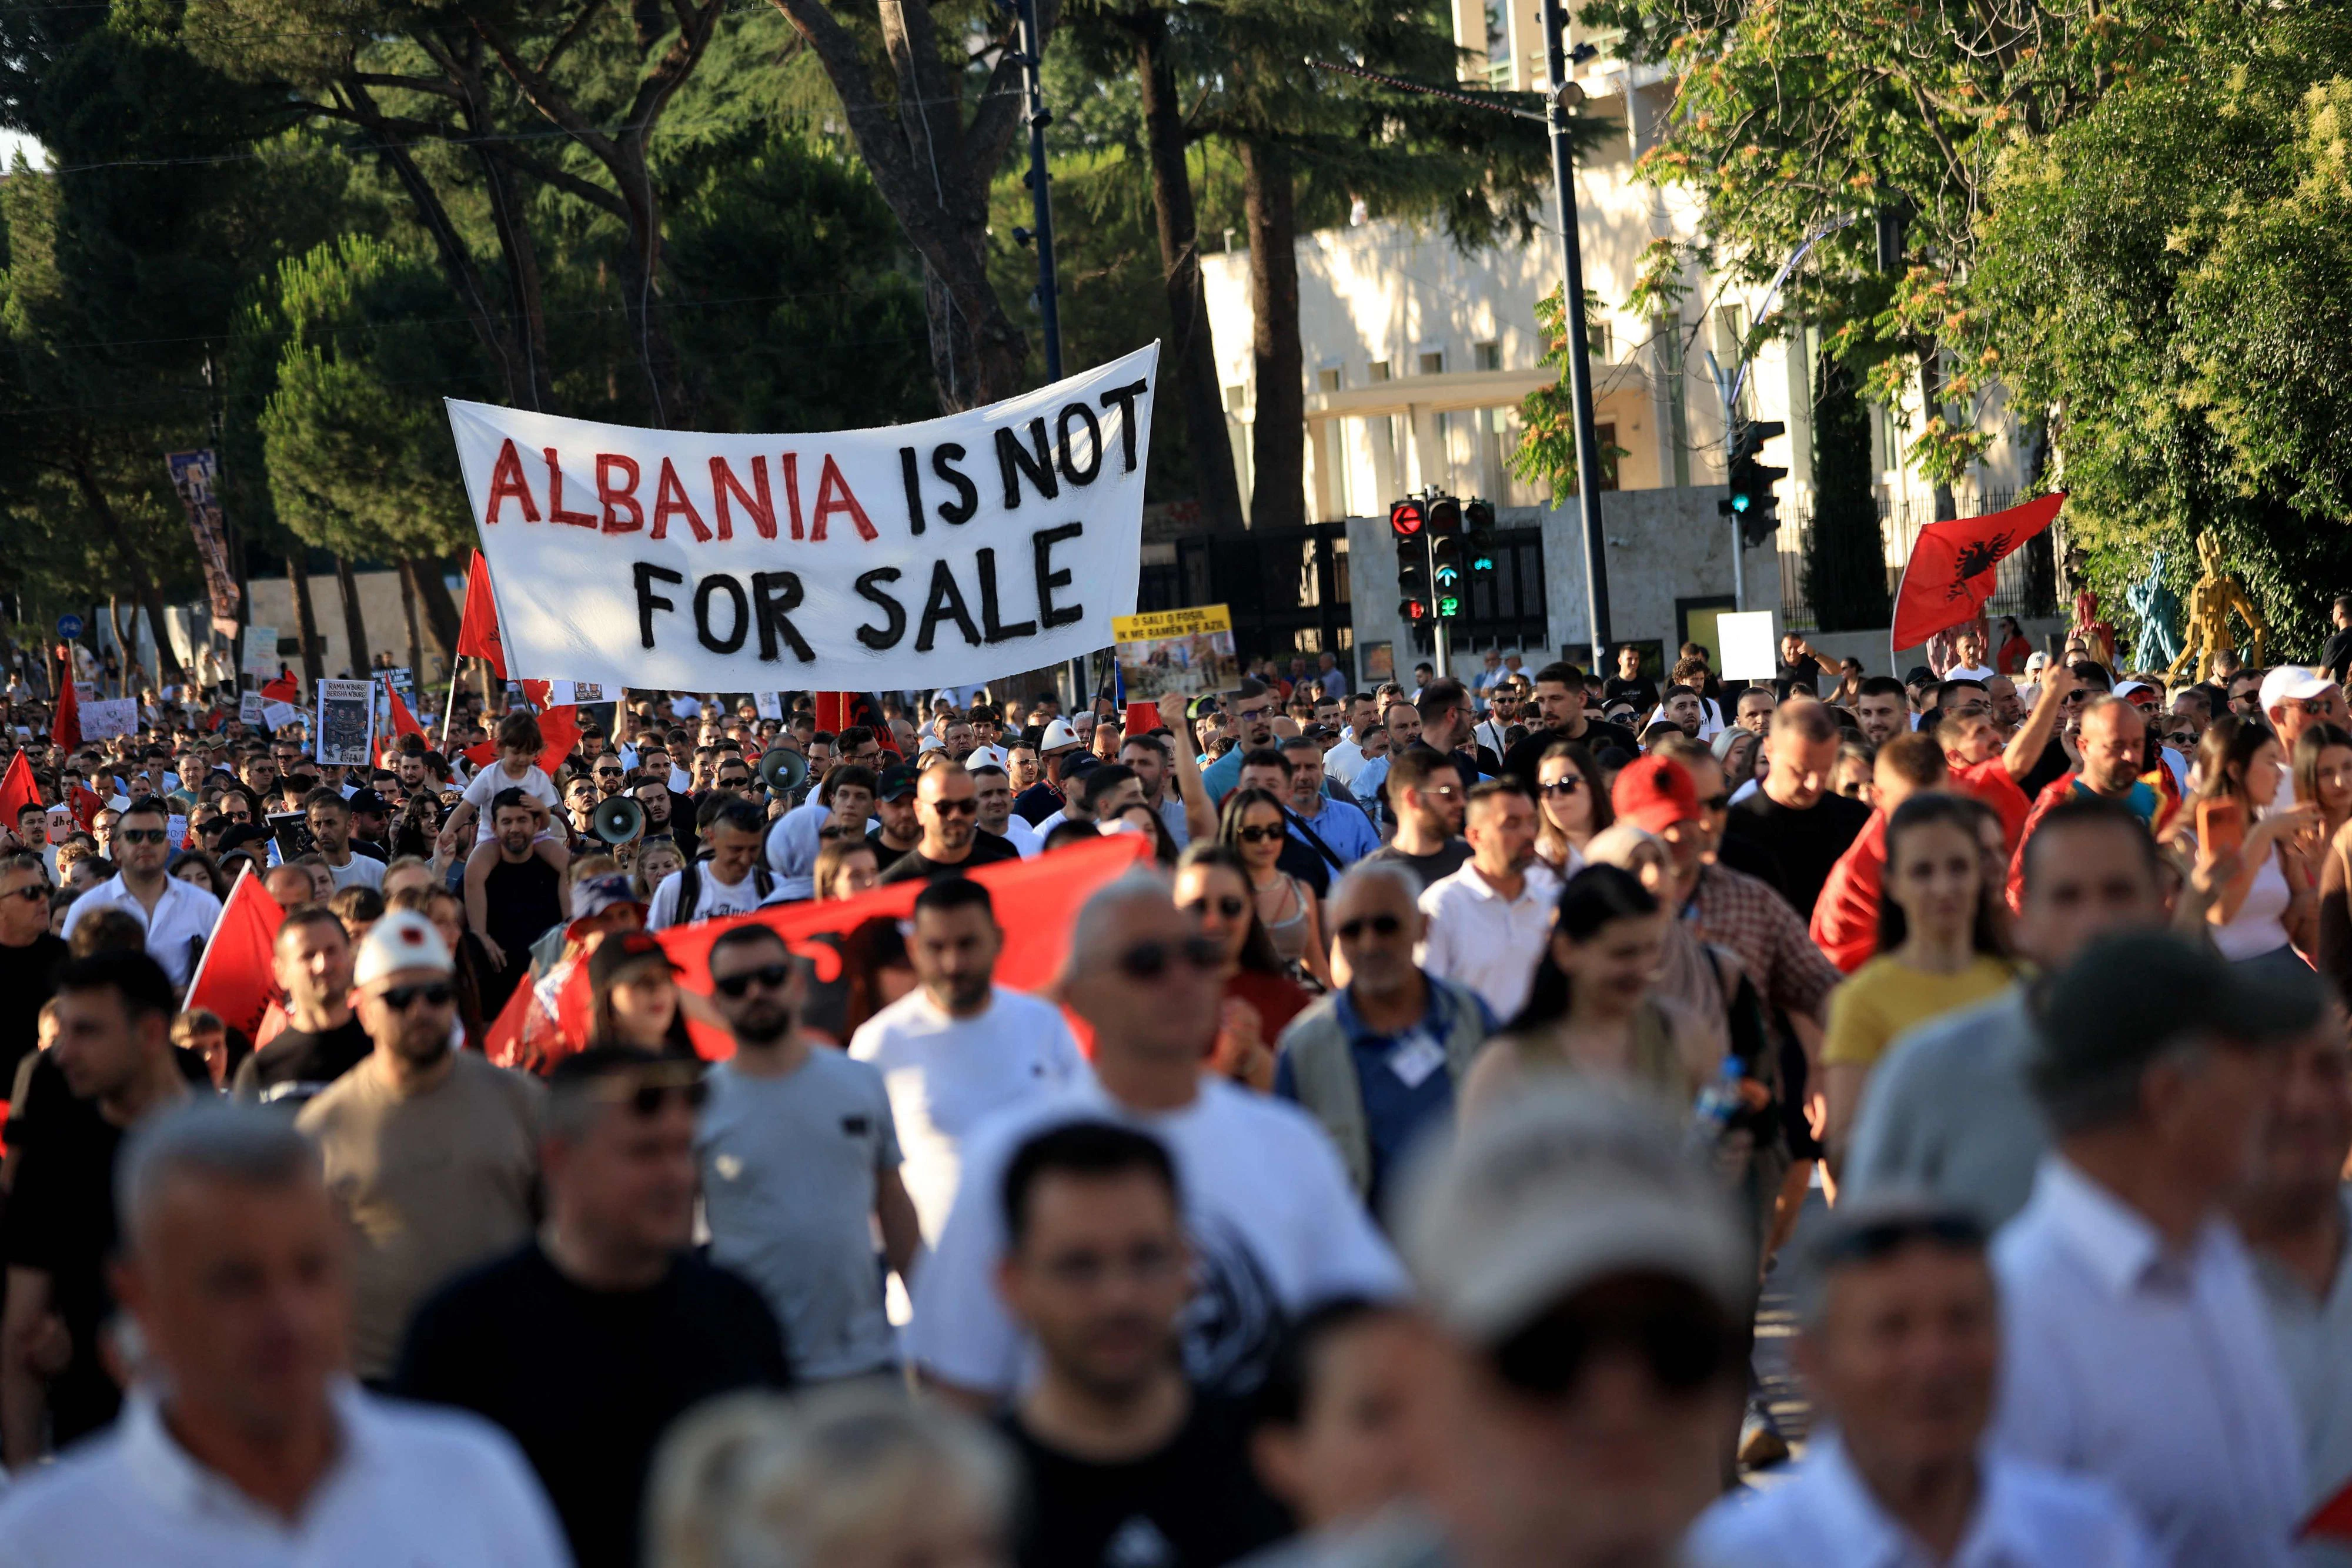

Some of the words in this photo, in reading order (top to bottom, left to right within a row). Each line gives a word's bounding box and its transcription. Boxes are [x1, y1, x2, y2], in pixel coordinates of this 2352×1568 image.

[485, 438, 879, 543] ALBANIA
[898, 442, 980, 536] IS
[994, 377, 1149, 510] NOT
[632, 561, 817, 663] FOR
[854, 521, 1084, 651] SALE
[1131, 617, 1140, 627] O
[1142, 615, 1164, 626] SALI
[1166, 614, 1174, 624] O
[1177, 610, 1205, 623] FOSIL
[1130, 630, 1145, 640] ME
[1204, 620, 1227, 631] AZIL
[328, 683, 345, 691] RAMA
[346, 683, 367, 691] N'BURG!
[52, 815, 71, 827] dhe
